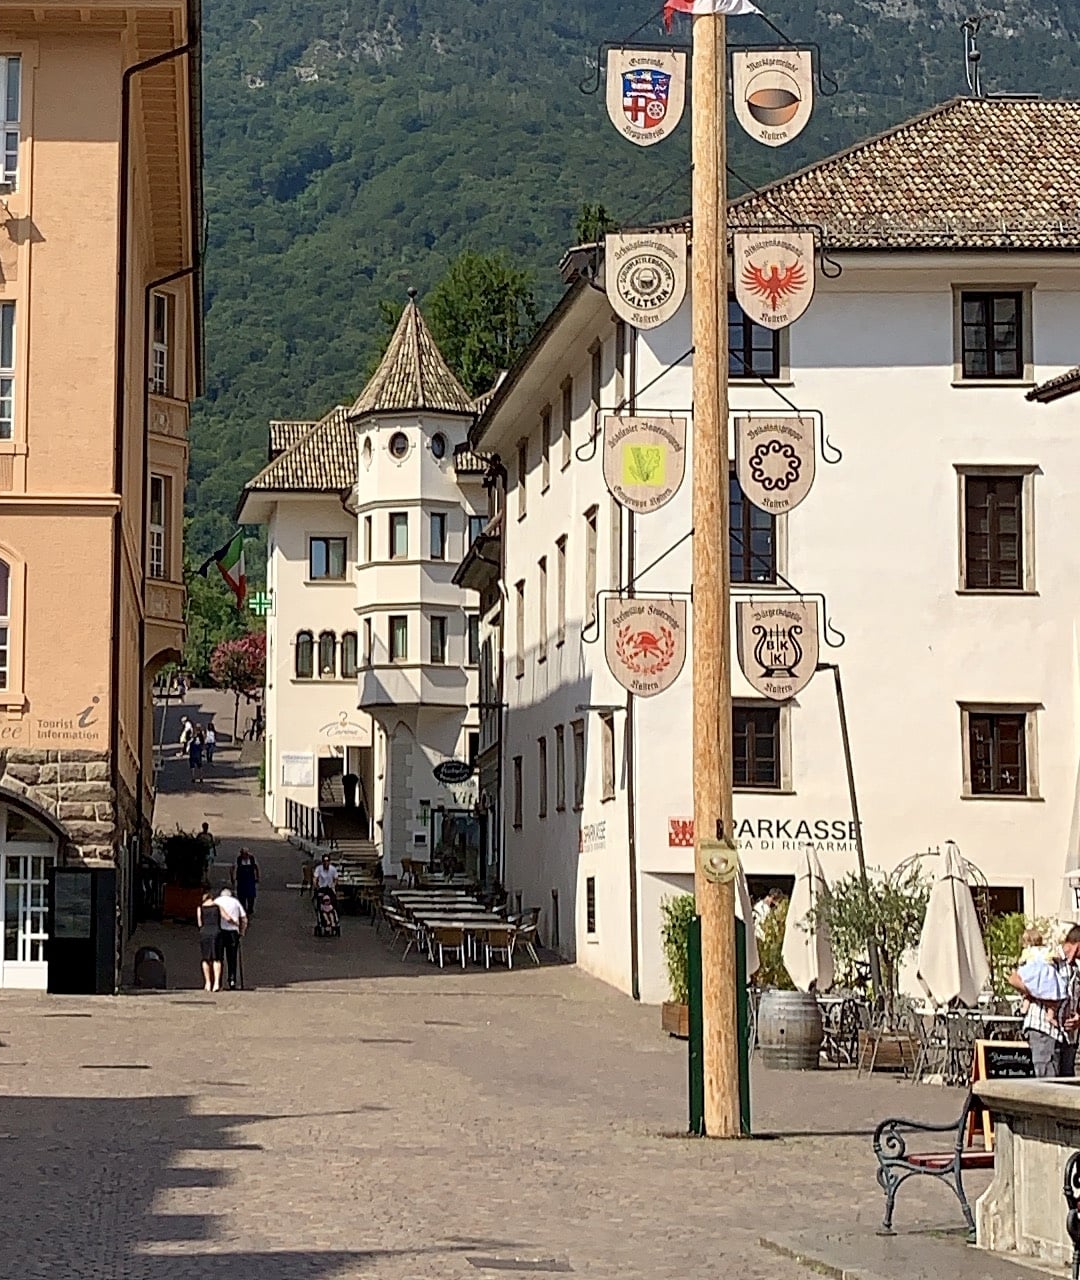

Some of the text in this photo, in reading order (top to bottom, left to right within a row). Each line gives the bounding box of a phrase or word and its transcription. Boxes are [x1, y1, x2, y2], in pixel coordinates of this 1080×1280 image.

[622, 288, 670, 308] KALTERN
[780, 640, 789, 651] K
[773, 653, 783, 665] K
[37, 719, 73, 730] Tourist
[37, 730, 100, 740] Information
[761, 840, 775, 850] DI
